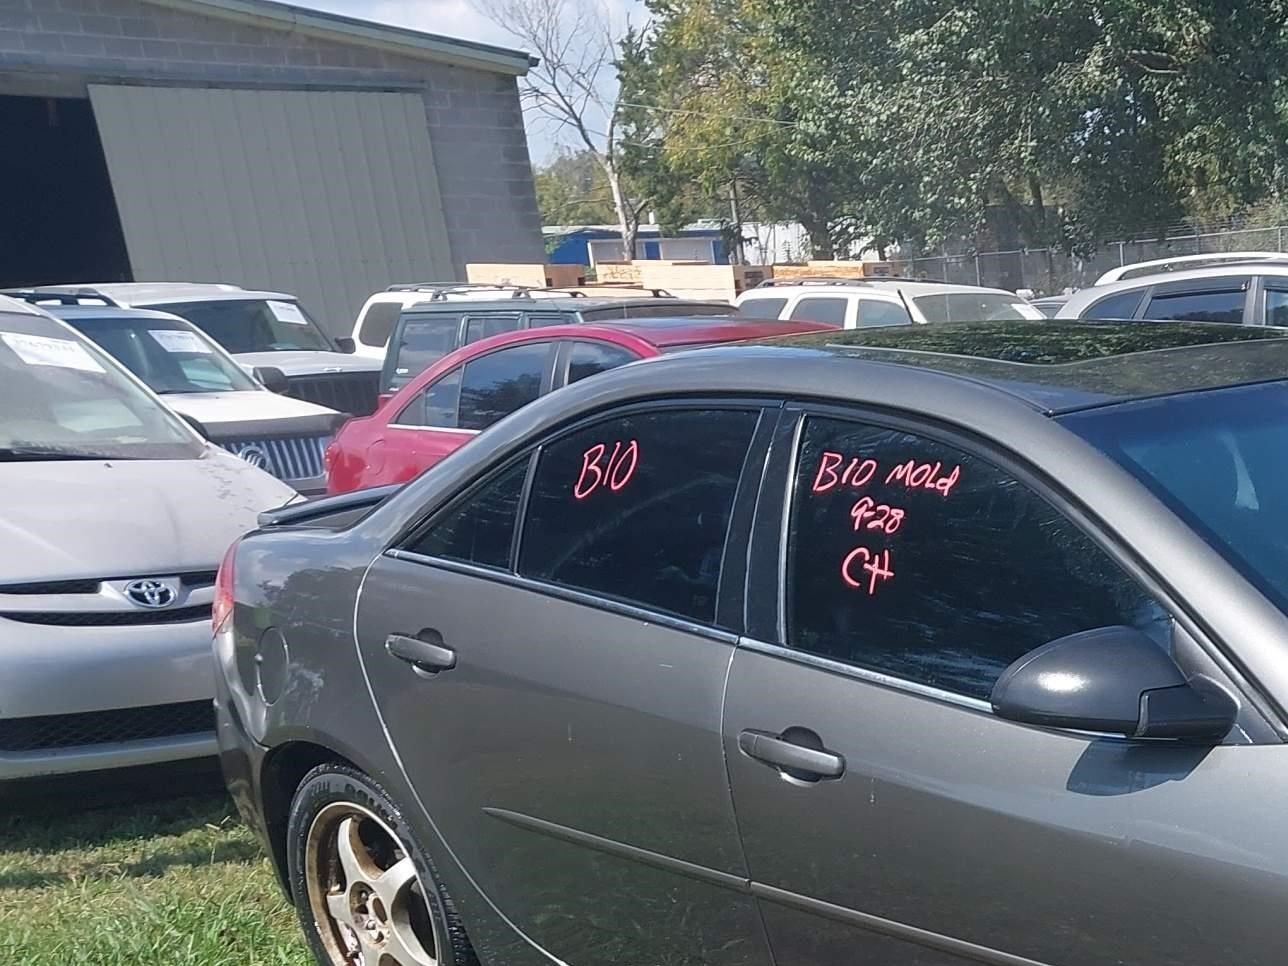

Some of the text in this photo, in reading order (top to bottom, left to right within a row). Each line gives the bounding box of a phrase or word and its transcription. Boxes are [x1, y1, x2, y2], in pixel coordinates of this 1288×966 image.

[574, 439, 638, 499] BIO
[812, 452, 877, 492] BIO
[850, 496, 905, 534] 9-28
